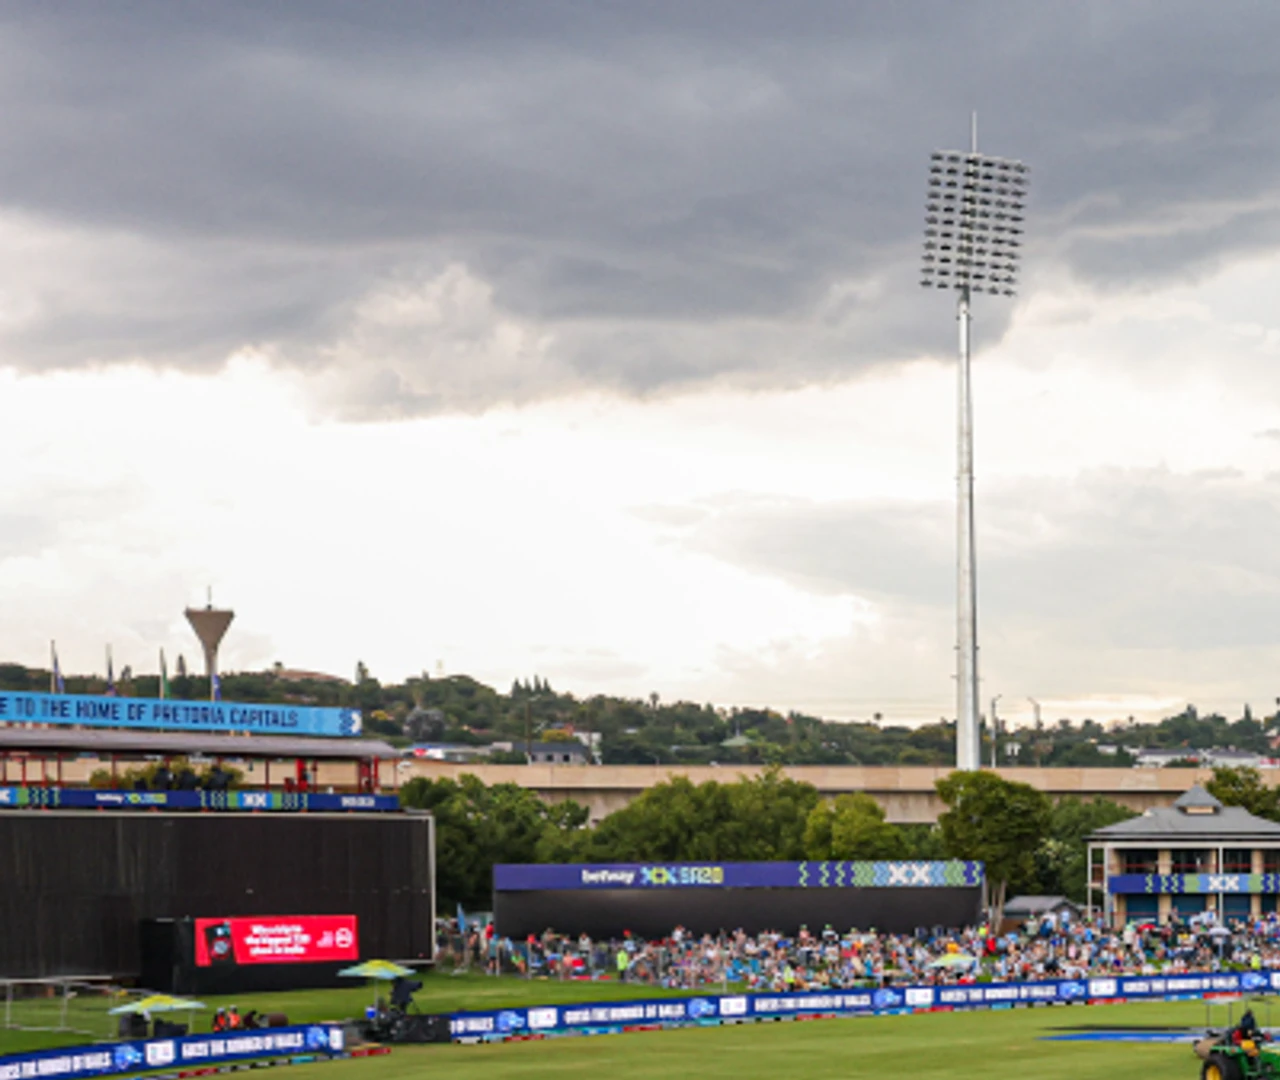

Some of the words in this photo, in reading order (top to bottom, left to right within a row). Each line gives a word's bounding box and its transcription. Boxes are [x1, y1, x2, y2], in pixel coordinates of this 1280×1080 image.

[16, 697, 36, 717] TO
[42, 699, 71, 718] THE
[76, 700, 121, 721] HOME
[127, 703, 147, 721] OF
[153, 704, 225, 724] PRETORIA
[230, 708, 299, 727] CAPITALS
[581, 869, 635, 885] betway
[680, 866, 724, 885] SA20
